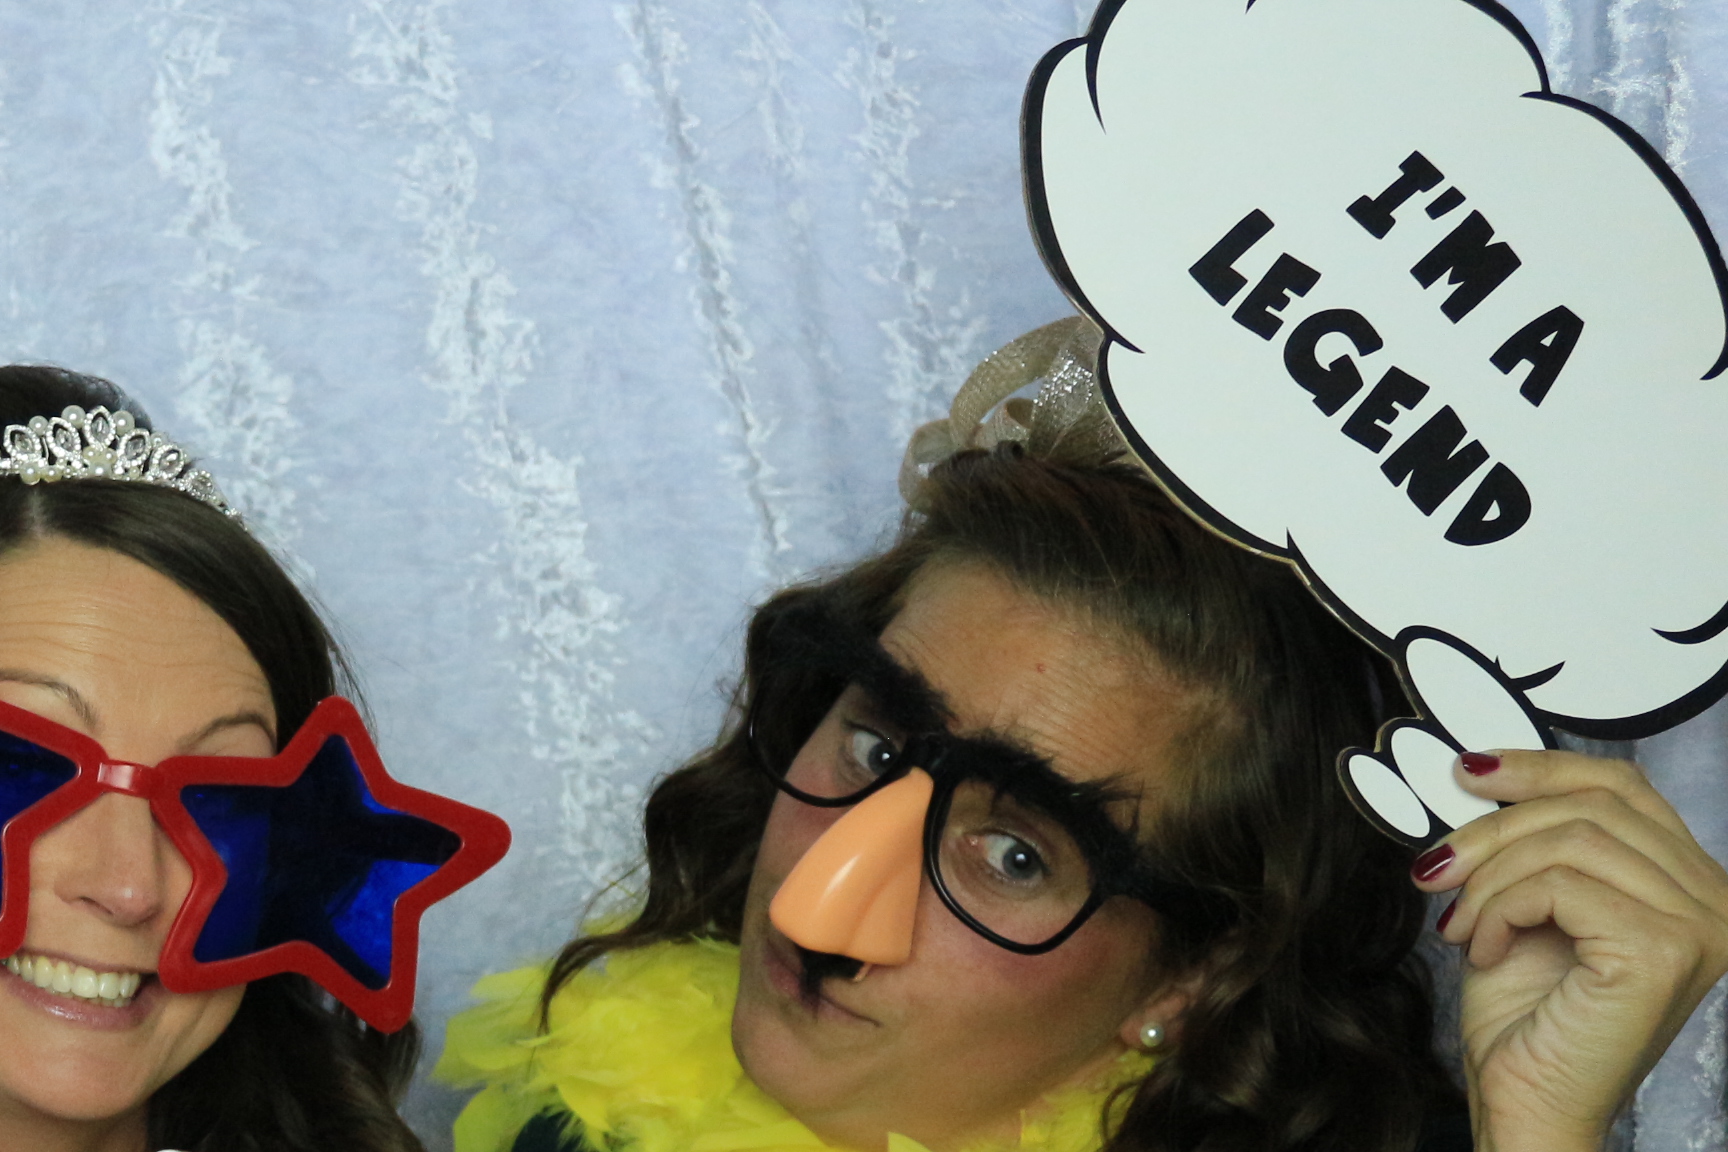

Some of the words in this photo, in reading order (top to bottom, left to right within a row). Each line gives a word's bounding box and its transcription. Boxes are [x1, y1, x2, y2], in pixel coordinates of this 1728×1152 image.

[1188, 208, 1532, 547] LEGEND
[1345, 150, 1522, 324] I'M
[1489, 305, 1584, 407] A
